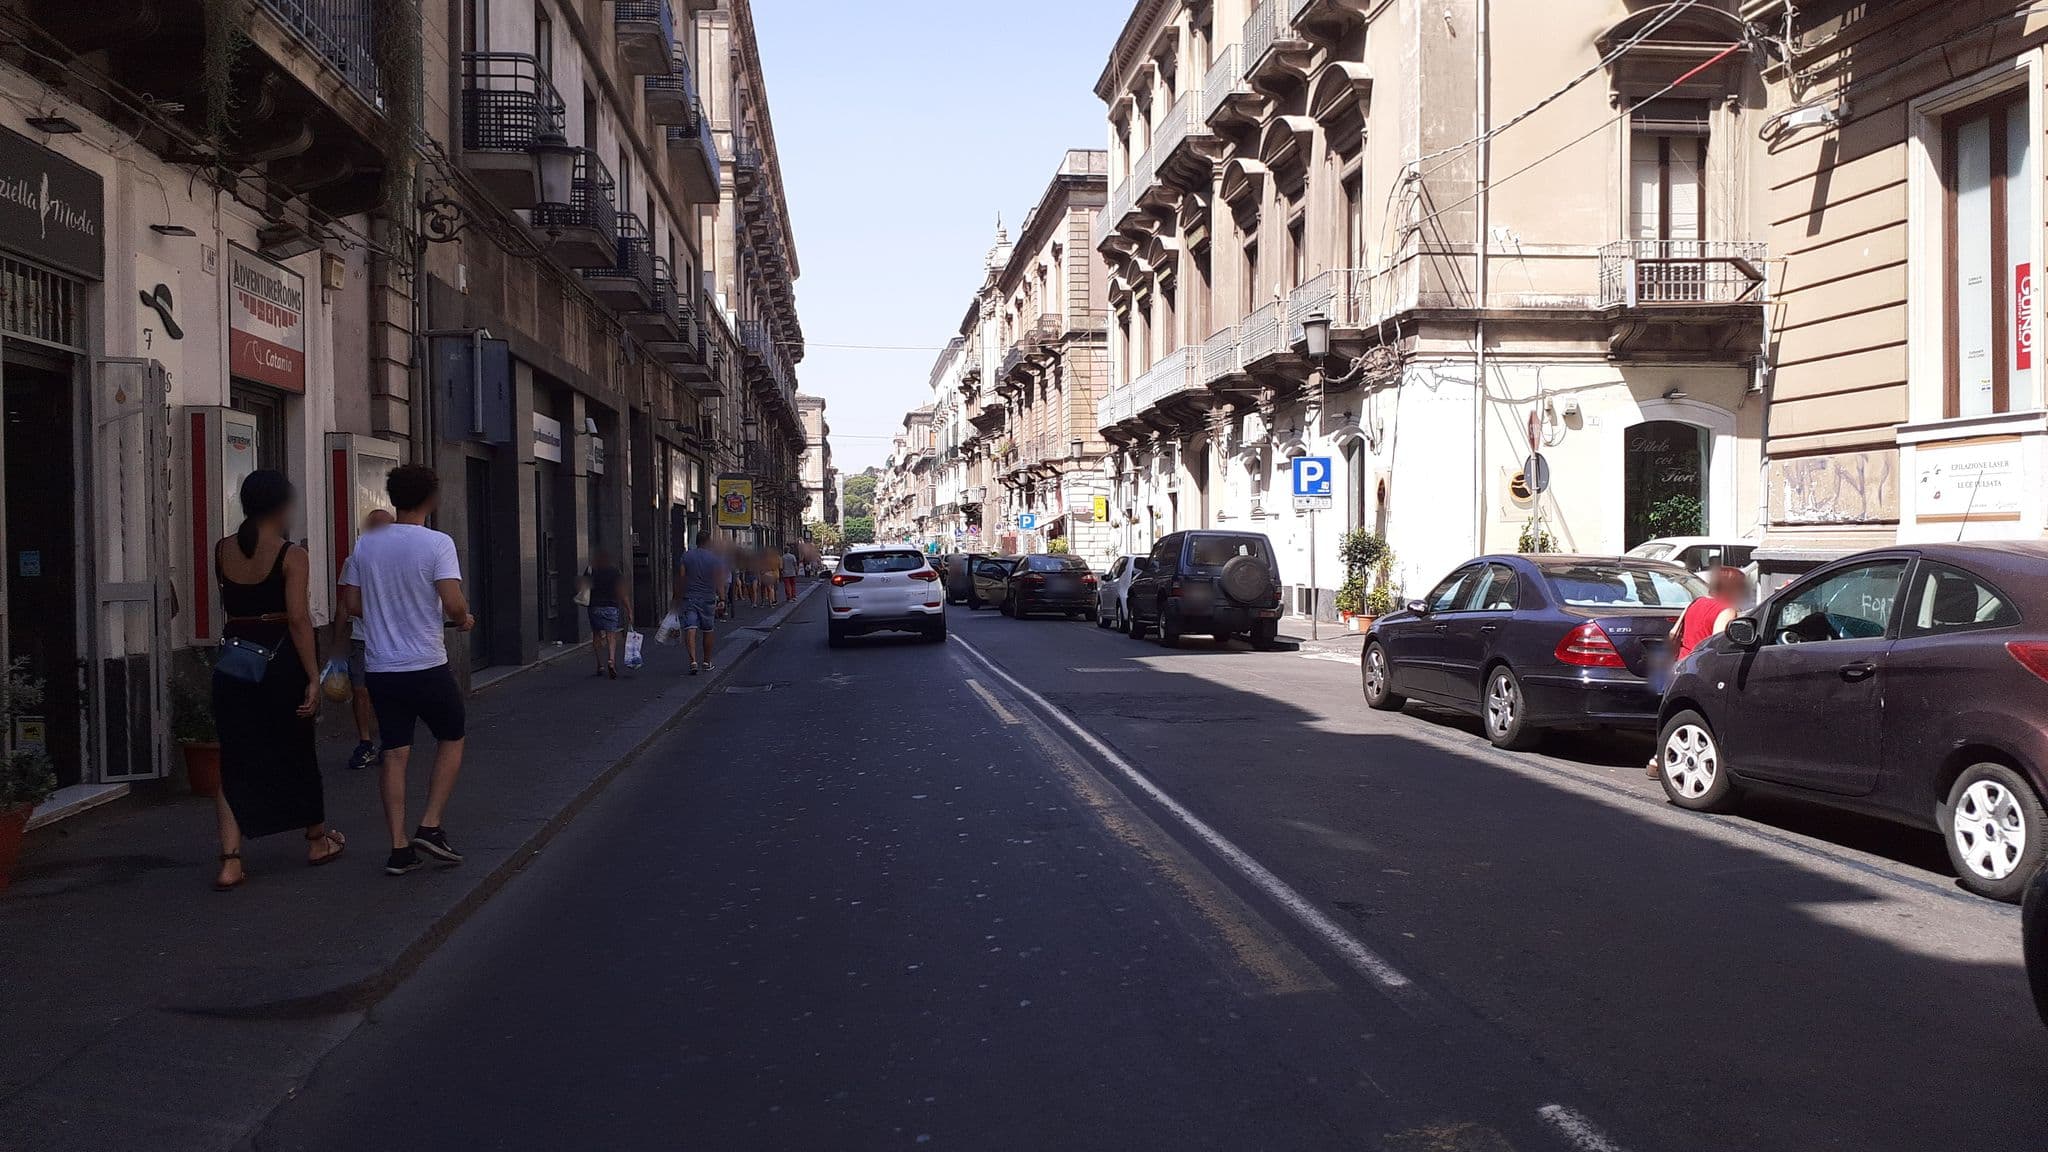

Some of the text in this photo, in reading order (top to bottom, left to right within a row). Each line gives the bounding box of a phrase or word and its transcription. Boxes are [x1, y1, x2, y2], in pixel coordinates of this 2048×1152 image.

[50, 199, 94, 236] Moda
[265, 348, 293, 373] Catania
[1300, 461, 1324, 492] P
[1951, 460, 2009, 471] EPILAZIONE LASER
[1023, 517, 1032, 528] P
